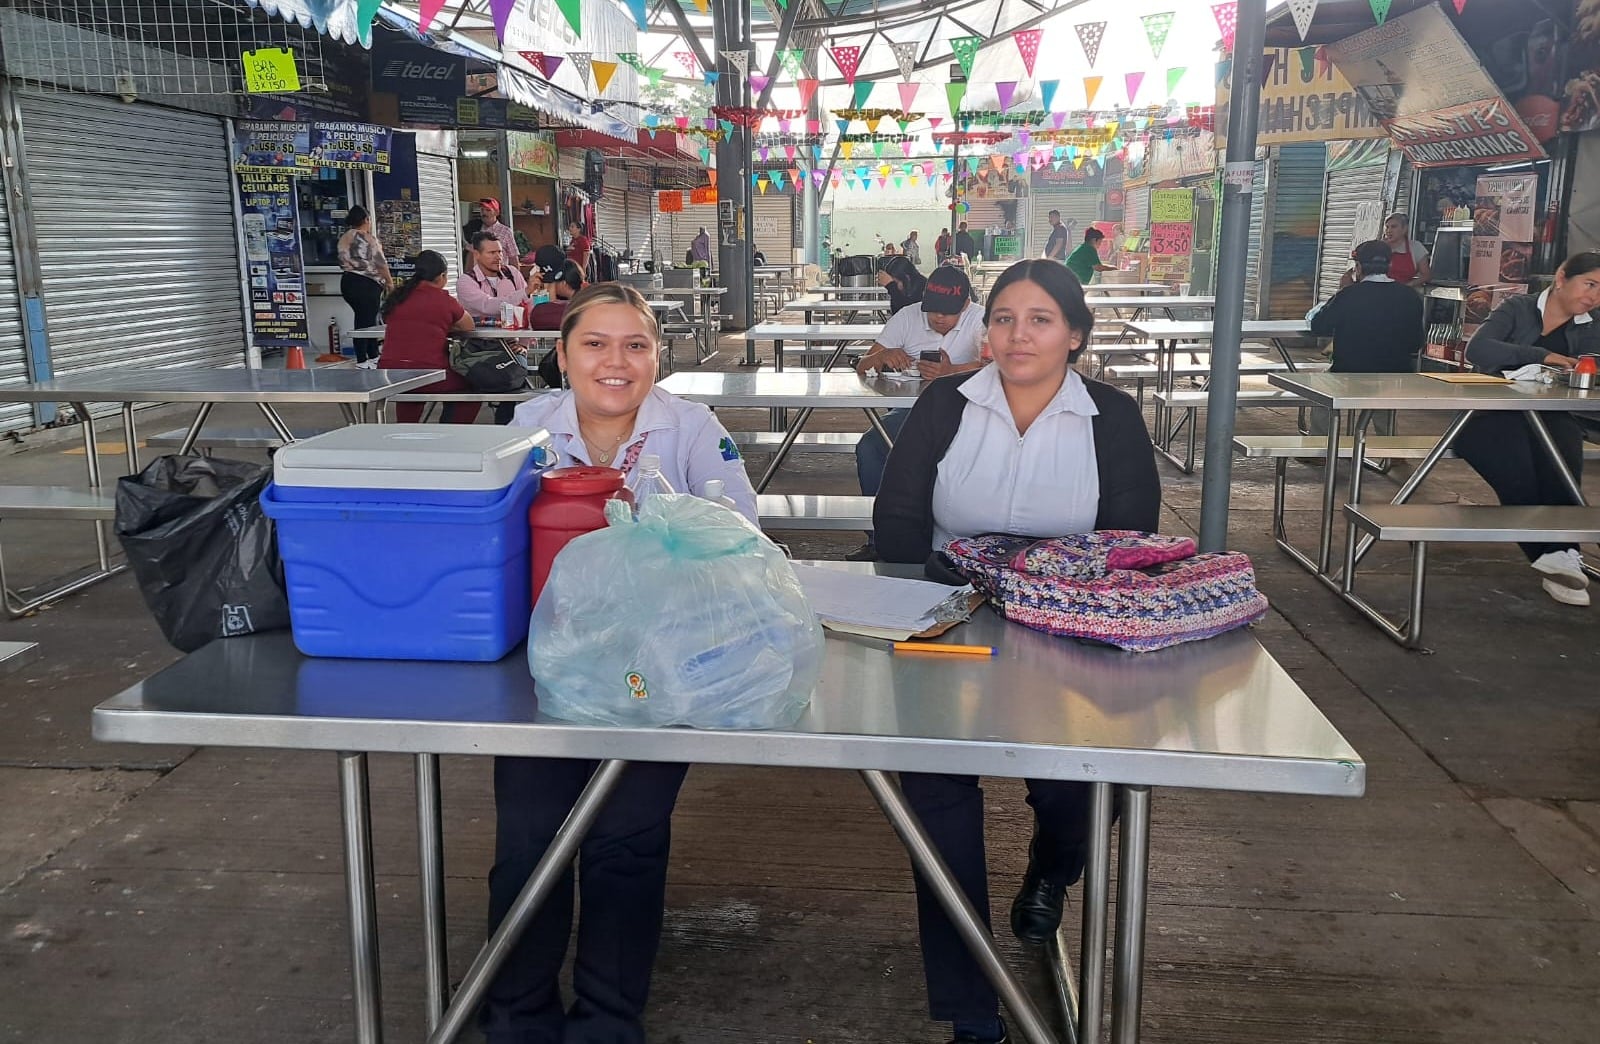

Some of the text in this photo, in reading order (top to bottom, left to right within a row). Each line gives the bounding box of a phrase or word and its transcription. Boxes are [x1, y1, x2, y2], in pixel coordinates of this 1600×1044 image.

[252, 60, 278, 73] BRA
[401, 61, 456, 80] telcel
[314, 122, 386, 136] GRABAMOS MUSICA
[256, 132, 295, 142] PELICULAS
[333, 132, 375, 142] PELICULAS
[259, 142, 276, 152] USB
[282, 144, 294, 154] SD
[338, 140, 355, 151] USB
[362, 143, 373, 154] SD
[1405, 130, 1528, 162] CAMPECHANAS
[313, 160, 338, 168] TALLER
[351, 162, 386, 172] CELULARES
[241, 174, 288, 183] TALLER DE
[241, 184, 290, 192] CELULARES
